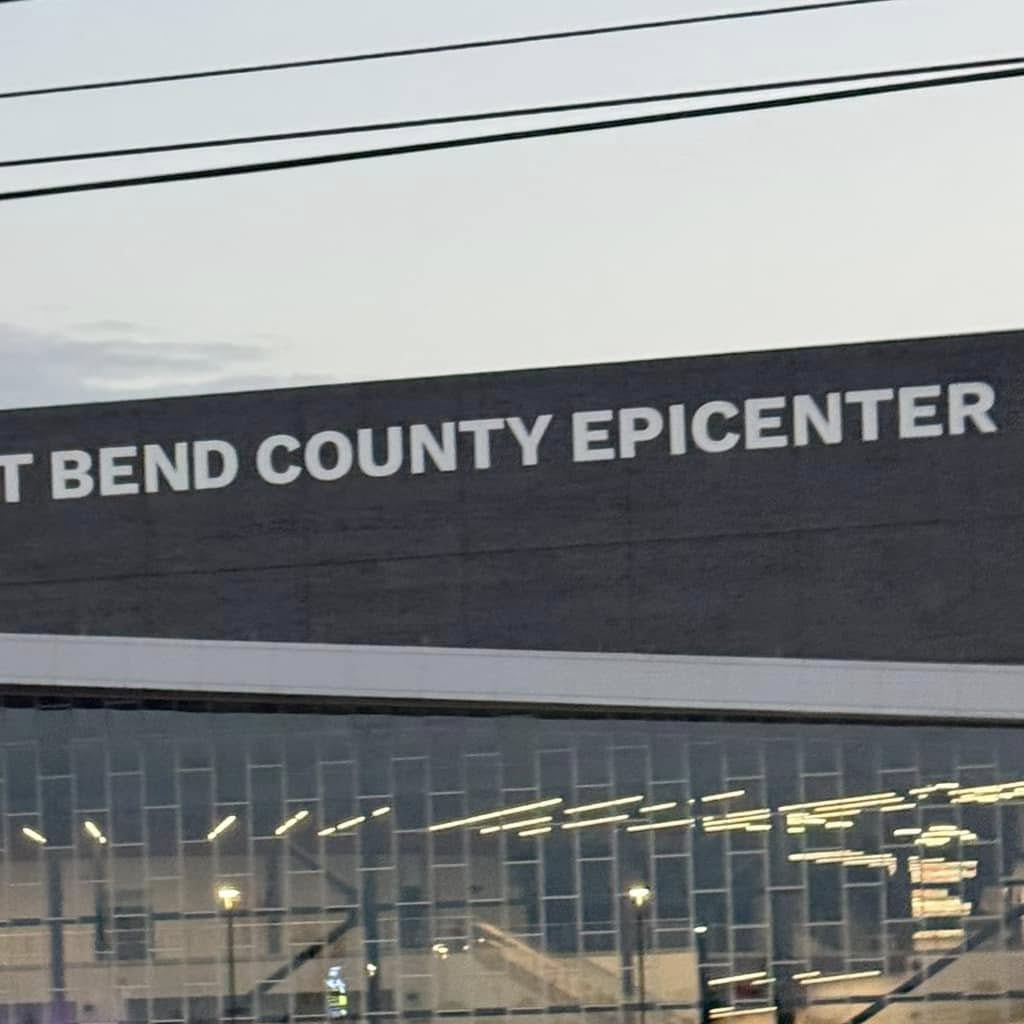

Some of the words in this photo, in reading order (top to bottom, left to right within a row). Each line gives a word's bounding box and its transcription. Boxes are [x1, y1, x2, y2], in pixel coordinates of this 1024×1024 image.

[50, 439, 239, 500] BEND
[256, 414, 553, 485] COUNTY
[572, 381, 998, 462] EPICENTER
